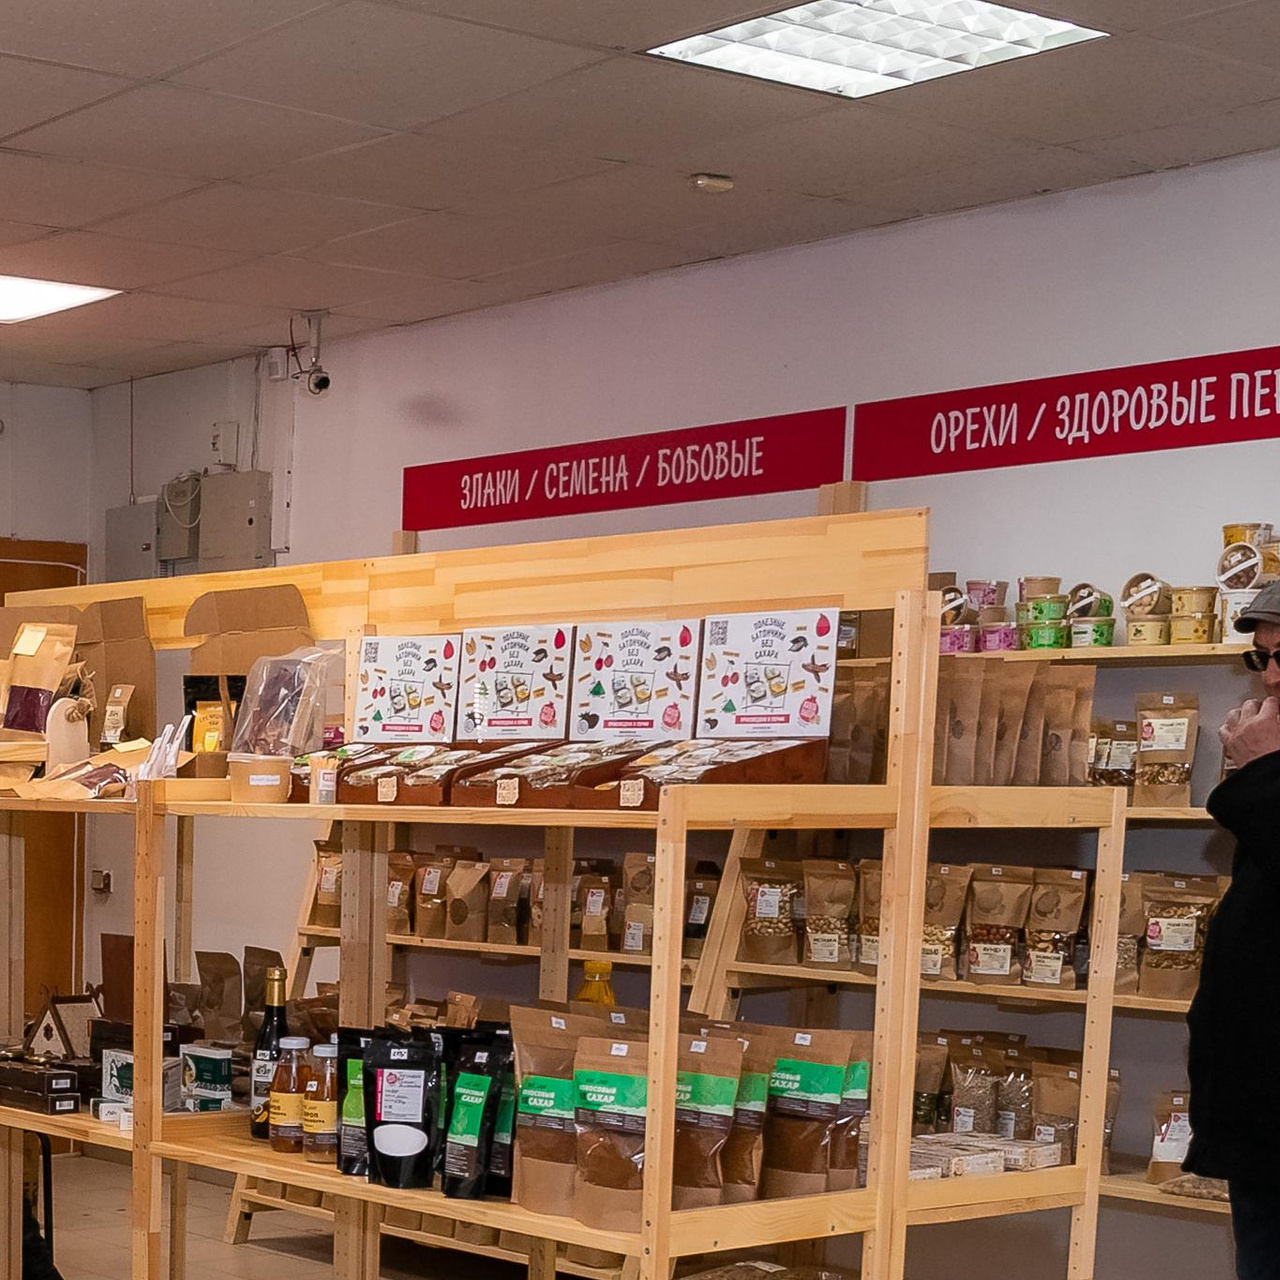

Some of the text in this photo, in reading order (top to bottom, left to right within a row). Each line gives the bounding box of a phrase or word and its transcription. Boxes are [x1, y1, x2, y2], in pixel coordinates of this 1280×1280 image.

[930, 402, 1018, 454] ОРЕХИ
[1055, 376, 1218, 446] ЗДОРОВЫЕ
[460, 468, 520, 510] ЗЛАКИ
[544, 454, 629, 500] СЕМЕНА
[657, 436, 765, 487] БОБОВЫЕ
[753, 617, 787, 630] ПОЛЕЗНЫЕ
[620, 627, 651, 640] ПОЛЕЗНЫЕ
[751, 629, 787, 643] БАТОНЧИКИ
[618, 639, 652, 651] БАТОНЧИКИ
[761, 639, 774, 648] БЕЗ
[627, 648, 639, 657] БЕЗ
[754, 650, 780, 660] САХАРА
[622, 658, 644, 668] САХАРА
[527, 1096, 556, 1108] САХАР
[586, 1092, 616, 1103] САХАР
